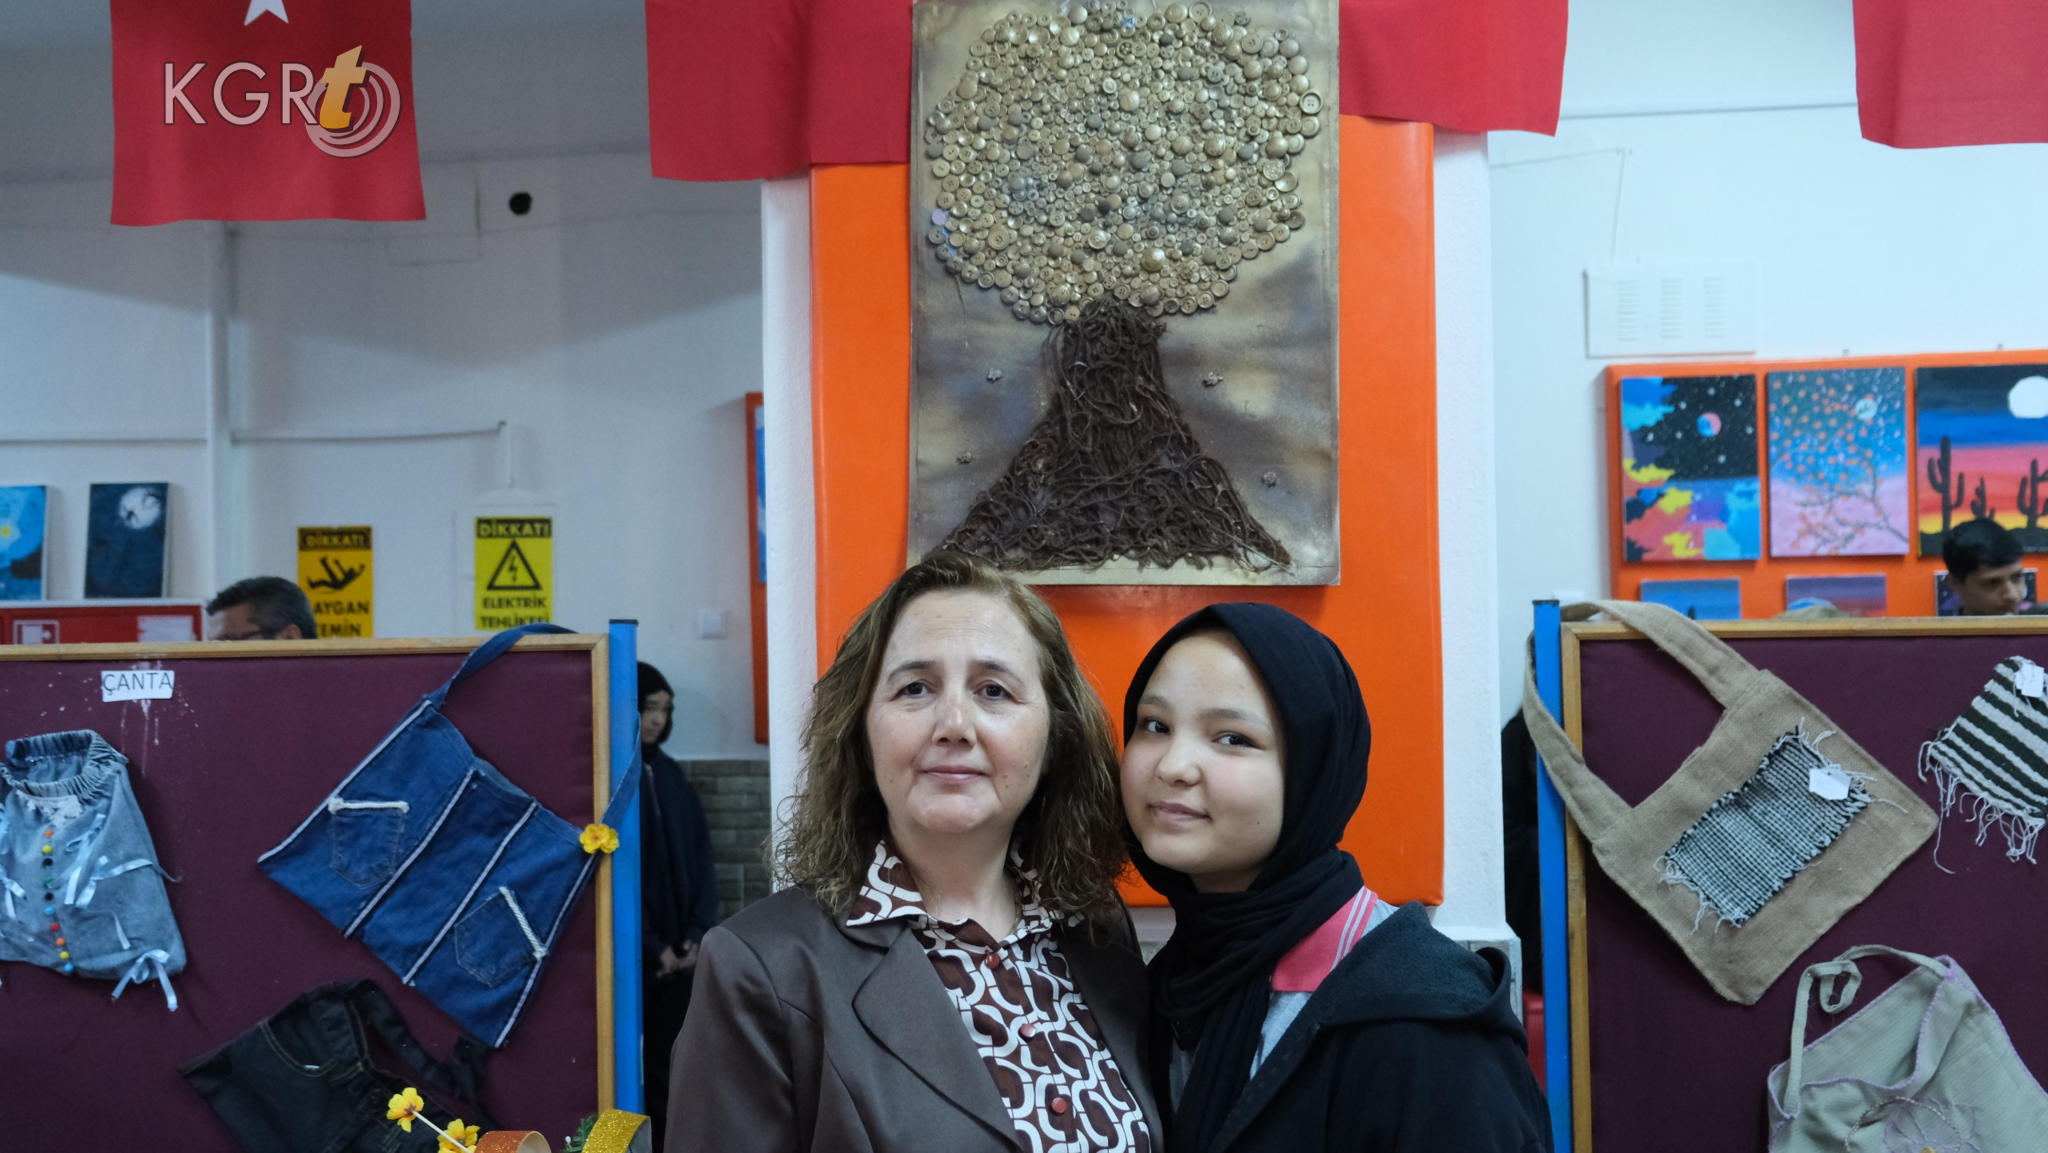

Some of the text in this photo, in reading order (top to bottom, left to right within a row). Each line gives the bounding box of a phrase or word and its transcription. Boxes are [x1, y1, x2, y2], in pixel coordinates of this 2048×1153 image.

[314, 601, 370, 616] AYGAN
[483, 594, 546, 609] ELEKTRİK
[320, 618, 362, 638] EMİN
[102, 672, 173, 696] ÇANTA
